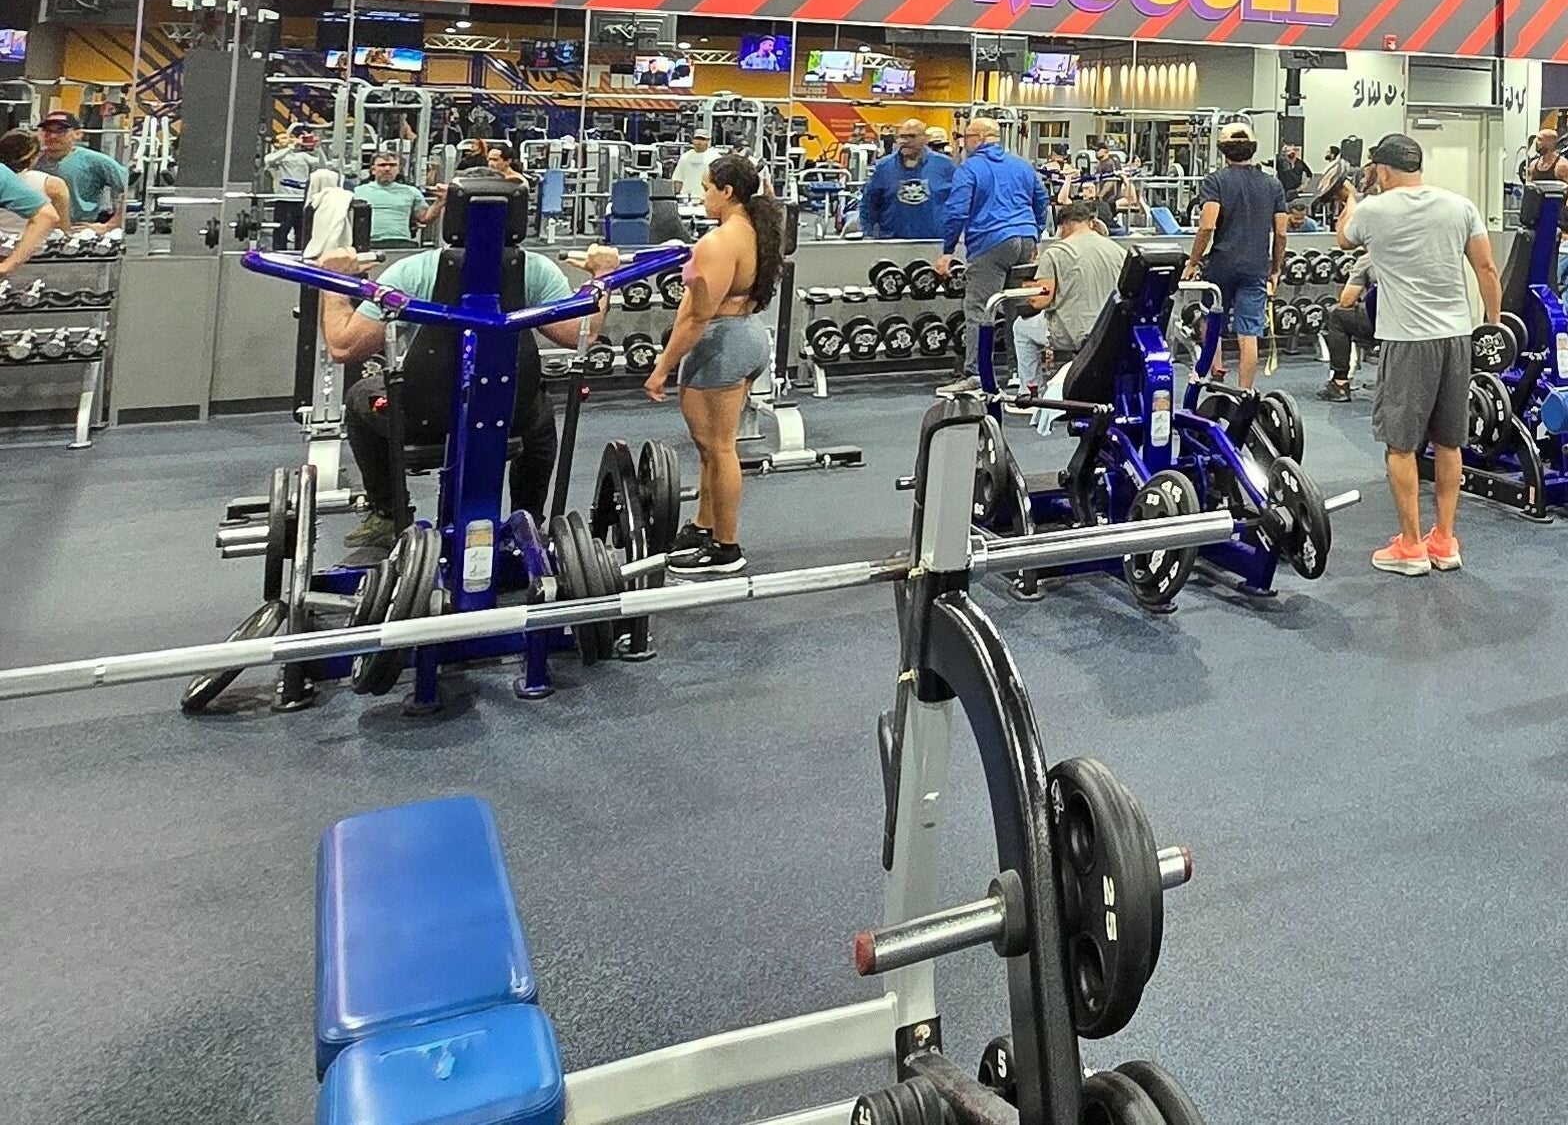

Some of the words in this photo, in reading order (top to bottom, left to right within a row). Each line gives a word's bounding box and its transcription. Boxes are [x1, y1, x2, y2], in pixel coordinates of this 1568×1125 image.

[1487, 353, 1502, 366] 25
[1102, 875, 1118, 942] 25
[997, 1048, 1008, 1078] 5
